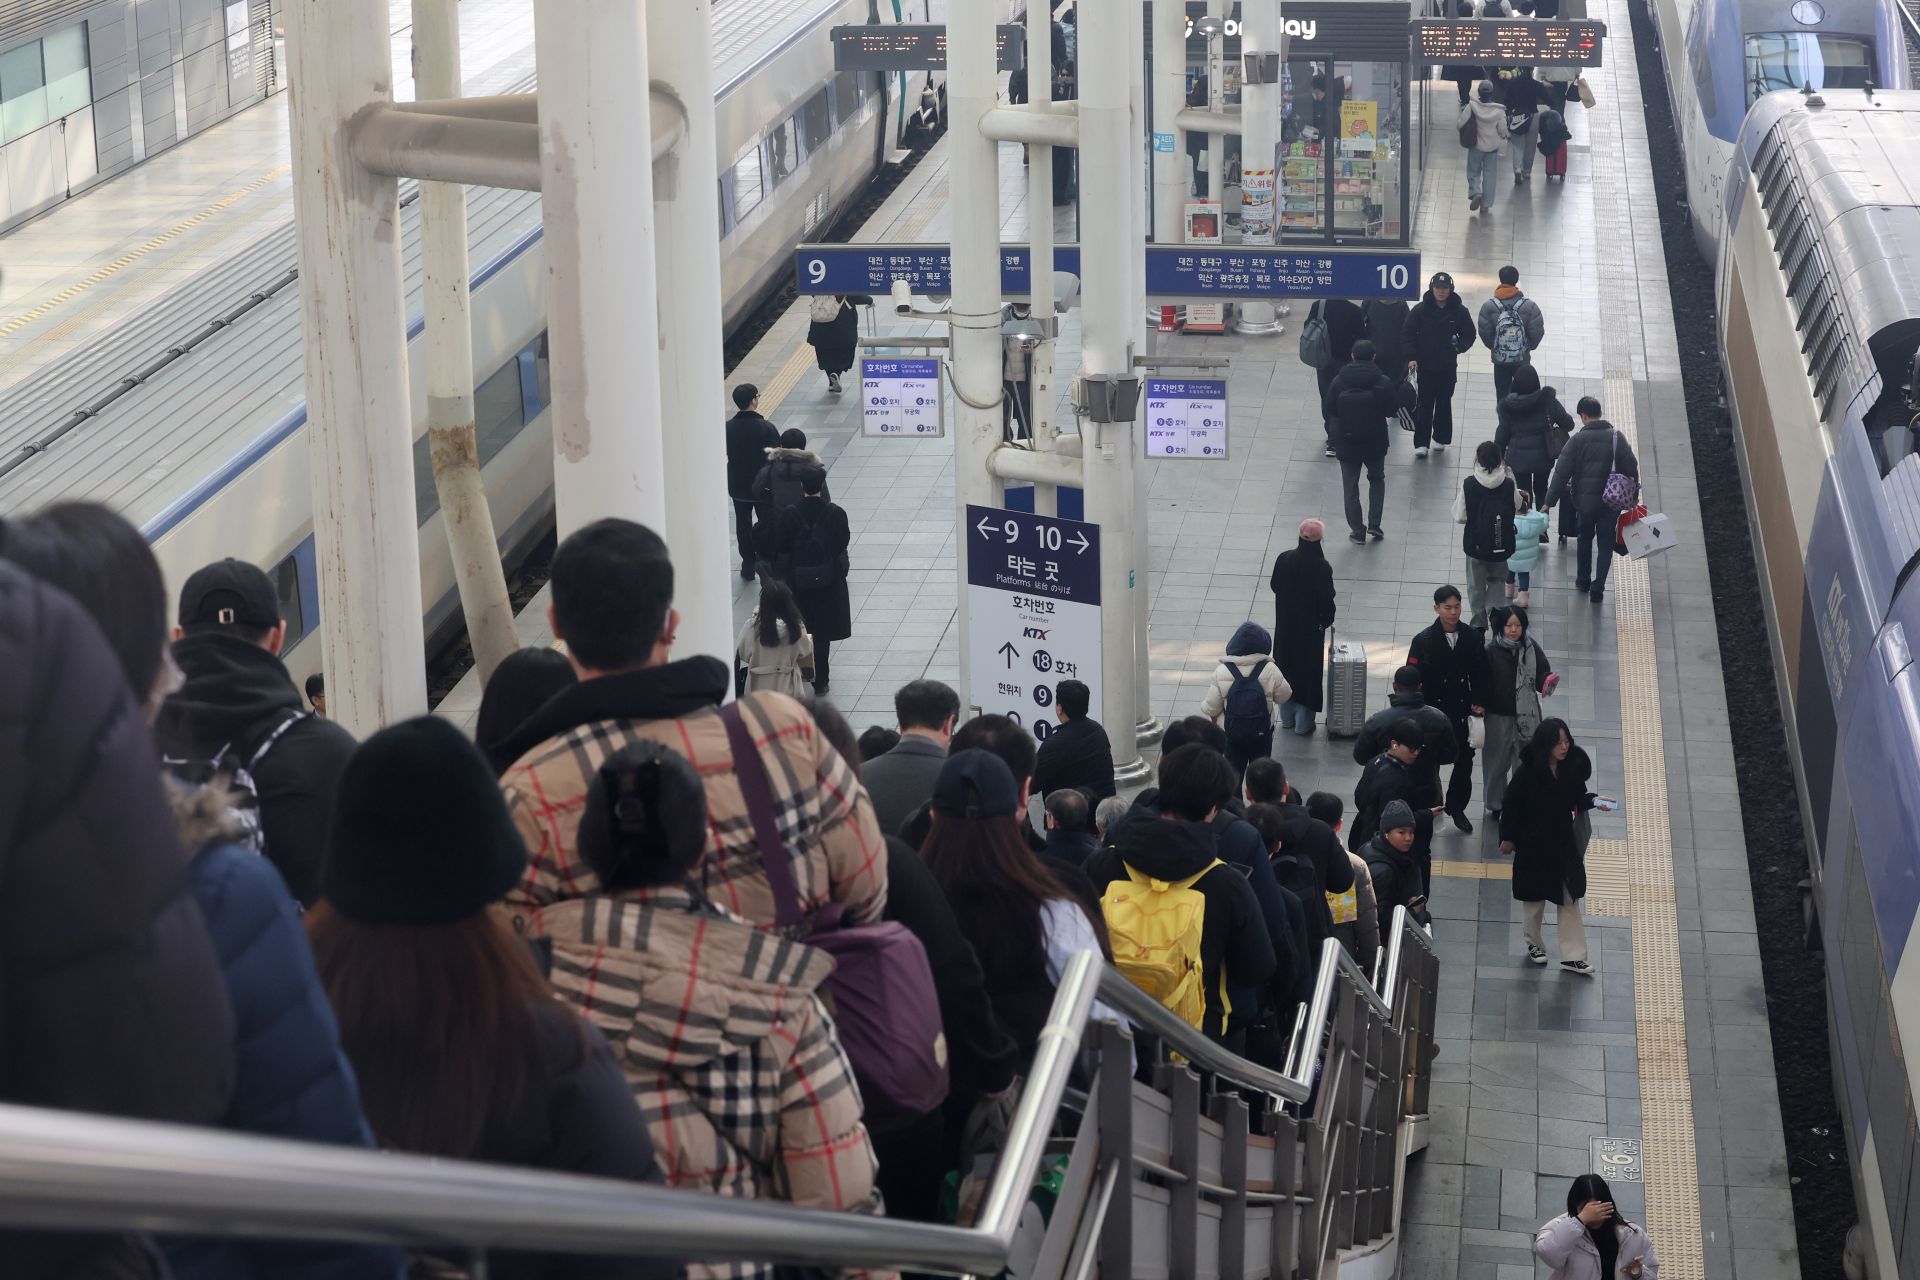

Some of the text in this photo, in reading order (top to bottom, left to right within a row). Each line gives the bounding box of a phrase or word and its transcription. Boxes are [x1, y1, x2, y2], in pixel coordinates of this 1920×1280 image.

[868, 256, 883, 265] 대전
[890, 256, 912, 266] 동대구
[918, 256, 934, 265] 부산
[1178, 257, 1194, 266] 대전
[1200, 258, 1222, 266] 동대구
[1230, 258, 1244, 267] 부산
[1252, 258, 1266, 268] 포항
[1274, 259, 1288, 268] 진주
[1296, 259, 1310, 268] 마산
[808, 259, 826, 284] 9
[868, 272, 884, 281] 익산
[890, 272, 919, 281] 광주송정
[926, 272, 940, 280] 목포
[1376, 264, 1408, 290] 10
[1198, 274, 1332, 285] 익산 광주송정 목포 여수EXPO 방면
[867, 364, 898, 373] 호차번호
[1153, 384, 1185, 393] 호차번호
[1004, 520, 1061, 551] 9 10
[1008, 555, 1058, 581] 타는 곳
[996, 574, 1031, 587] Platforms
[1050, 584, 1071, 594] のりば
[1012, 596, 1055, 614] 호차번호
[1023, 627, 1050, 640] KTX
[1034, 652, 1077, 678] 18 호차
[998, 682, 1021, 697] 현위치
